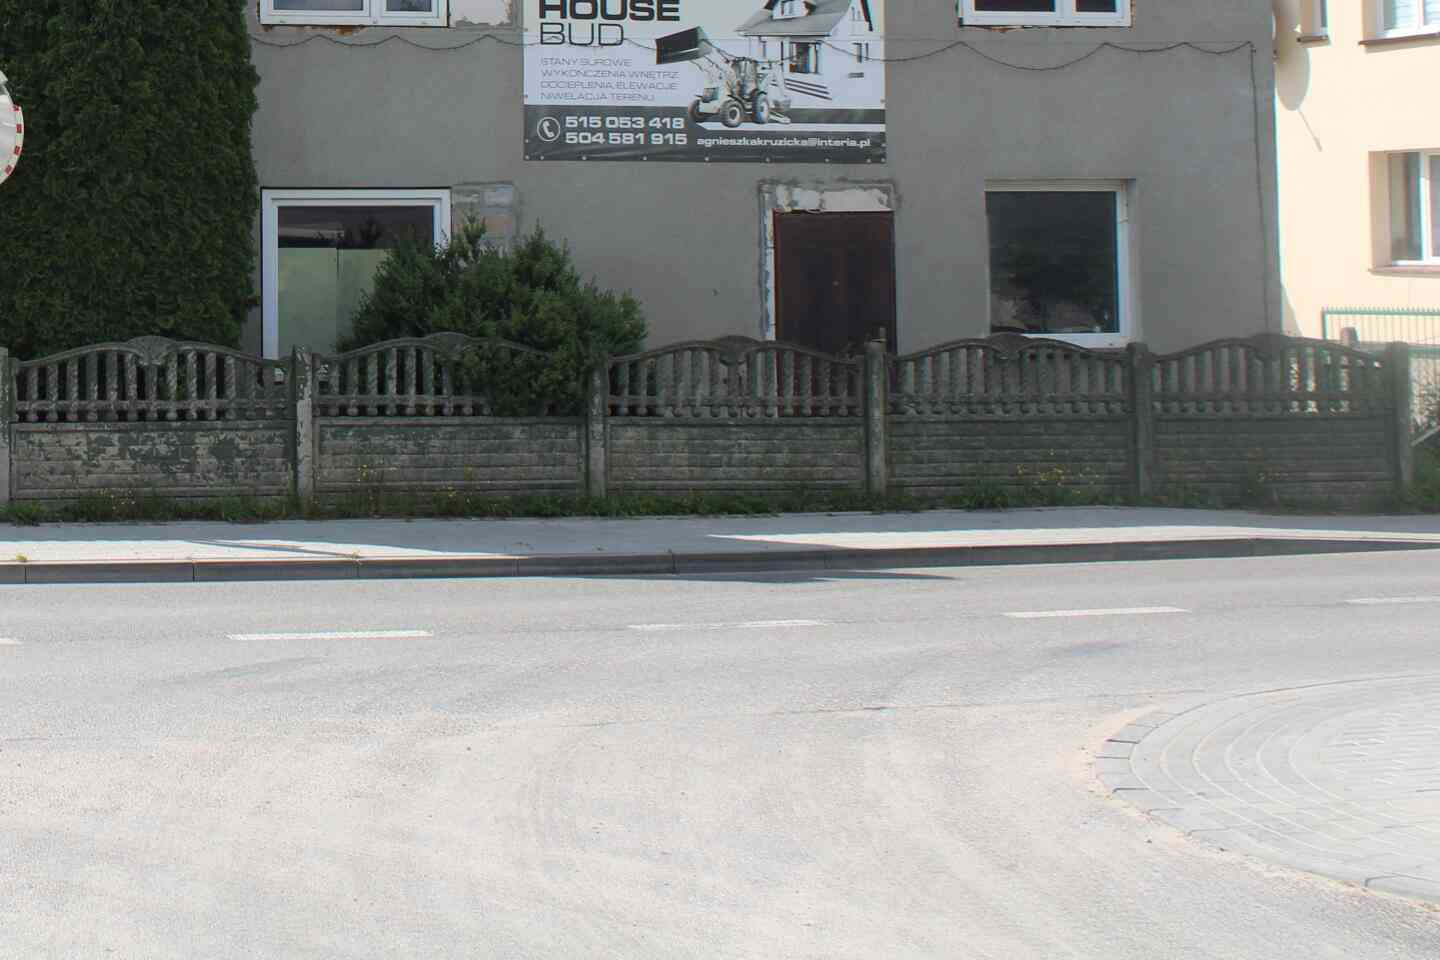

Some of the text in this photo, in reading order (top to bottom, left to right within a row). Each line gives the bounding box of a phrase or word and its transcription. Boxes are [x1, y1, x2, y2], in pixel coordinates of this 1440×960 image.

[540, 23, 624, 46] BUD
[540, 57, 632, 67] STANY SUROWE
[616, 82, 679, 91] ELEWACJE
[540, 92, 655, 101] NIWELACJA TERENU
[565, 116, 685, 129] 515 053 418
[565, 132, 688, 145] 504 581 915
